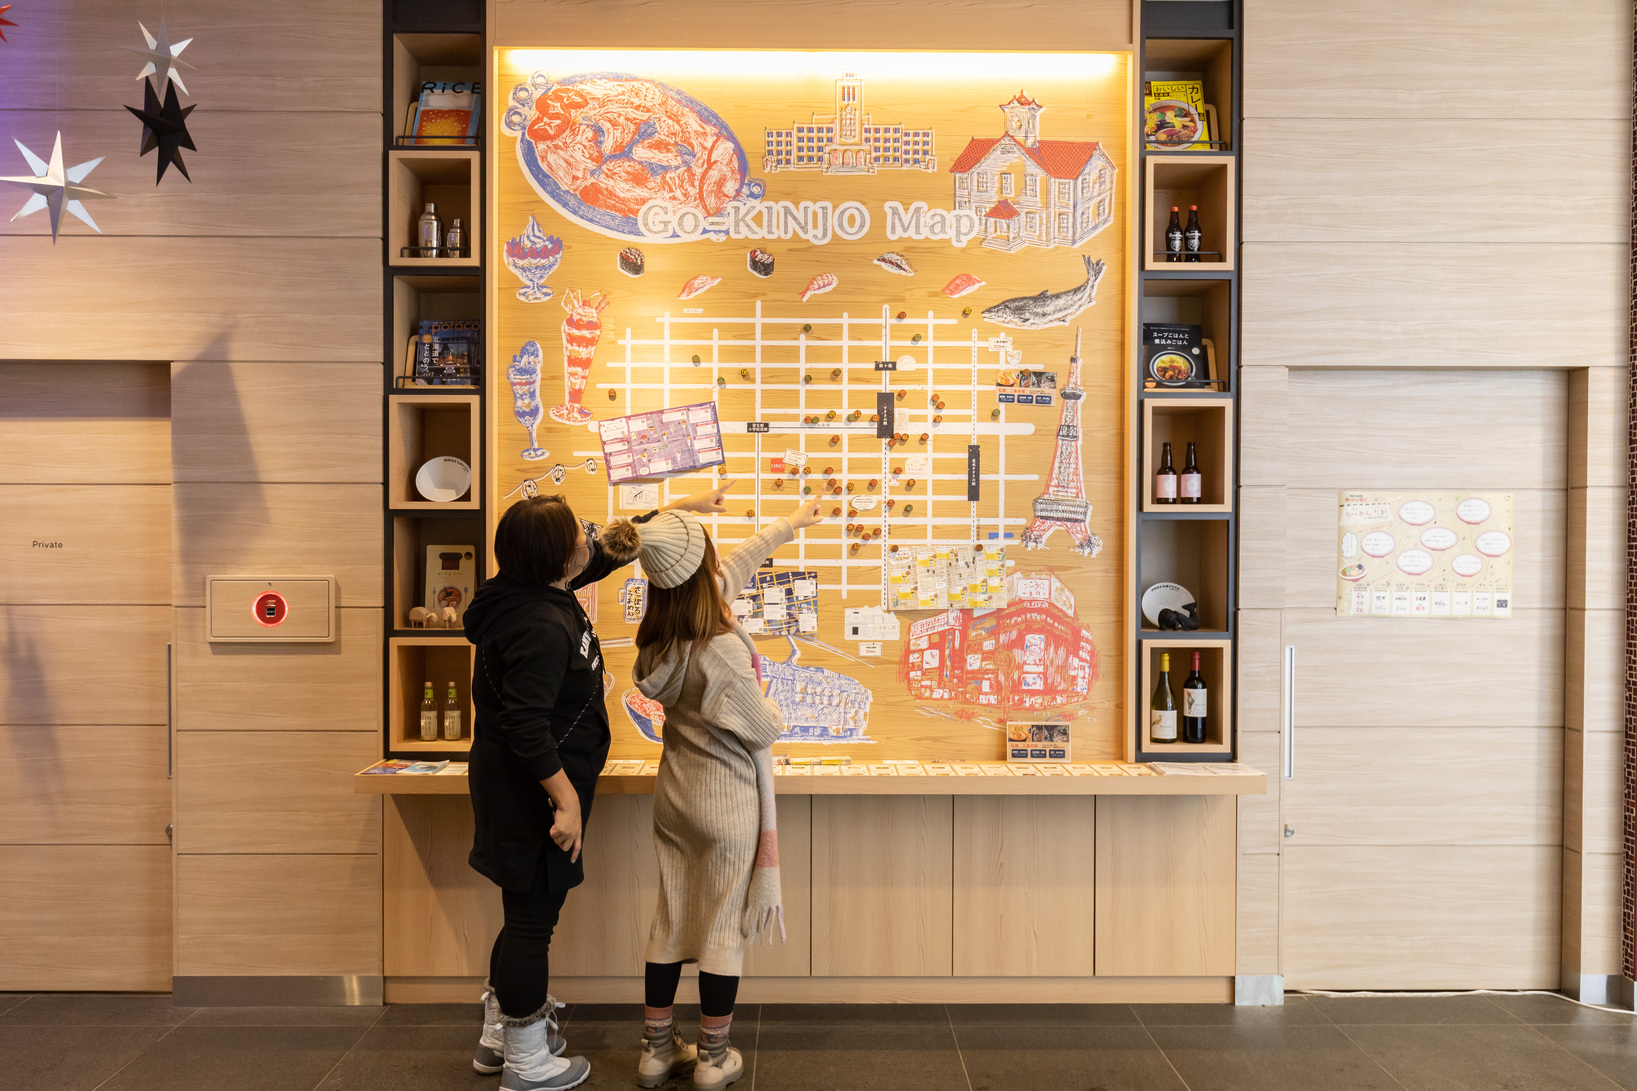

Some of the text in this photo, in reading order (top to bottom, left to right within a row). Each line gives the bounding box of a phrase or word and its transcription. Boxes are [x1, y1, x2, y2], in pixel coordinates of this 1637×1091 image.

[642, 204, 976, 243] Go-KINJO Map
[432, 323, 480, 335] poroco
[32, 540, 63, 549] Private
